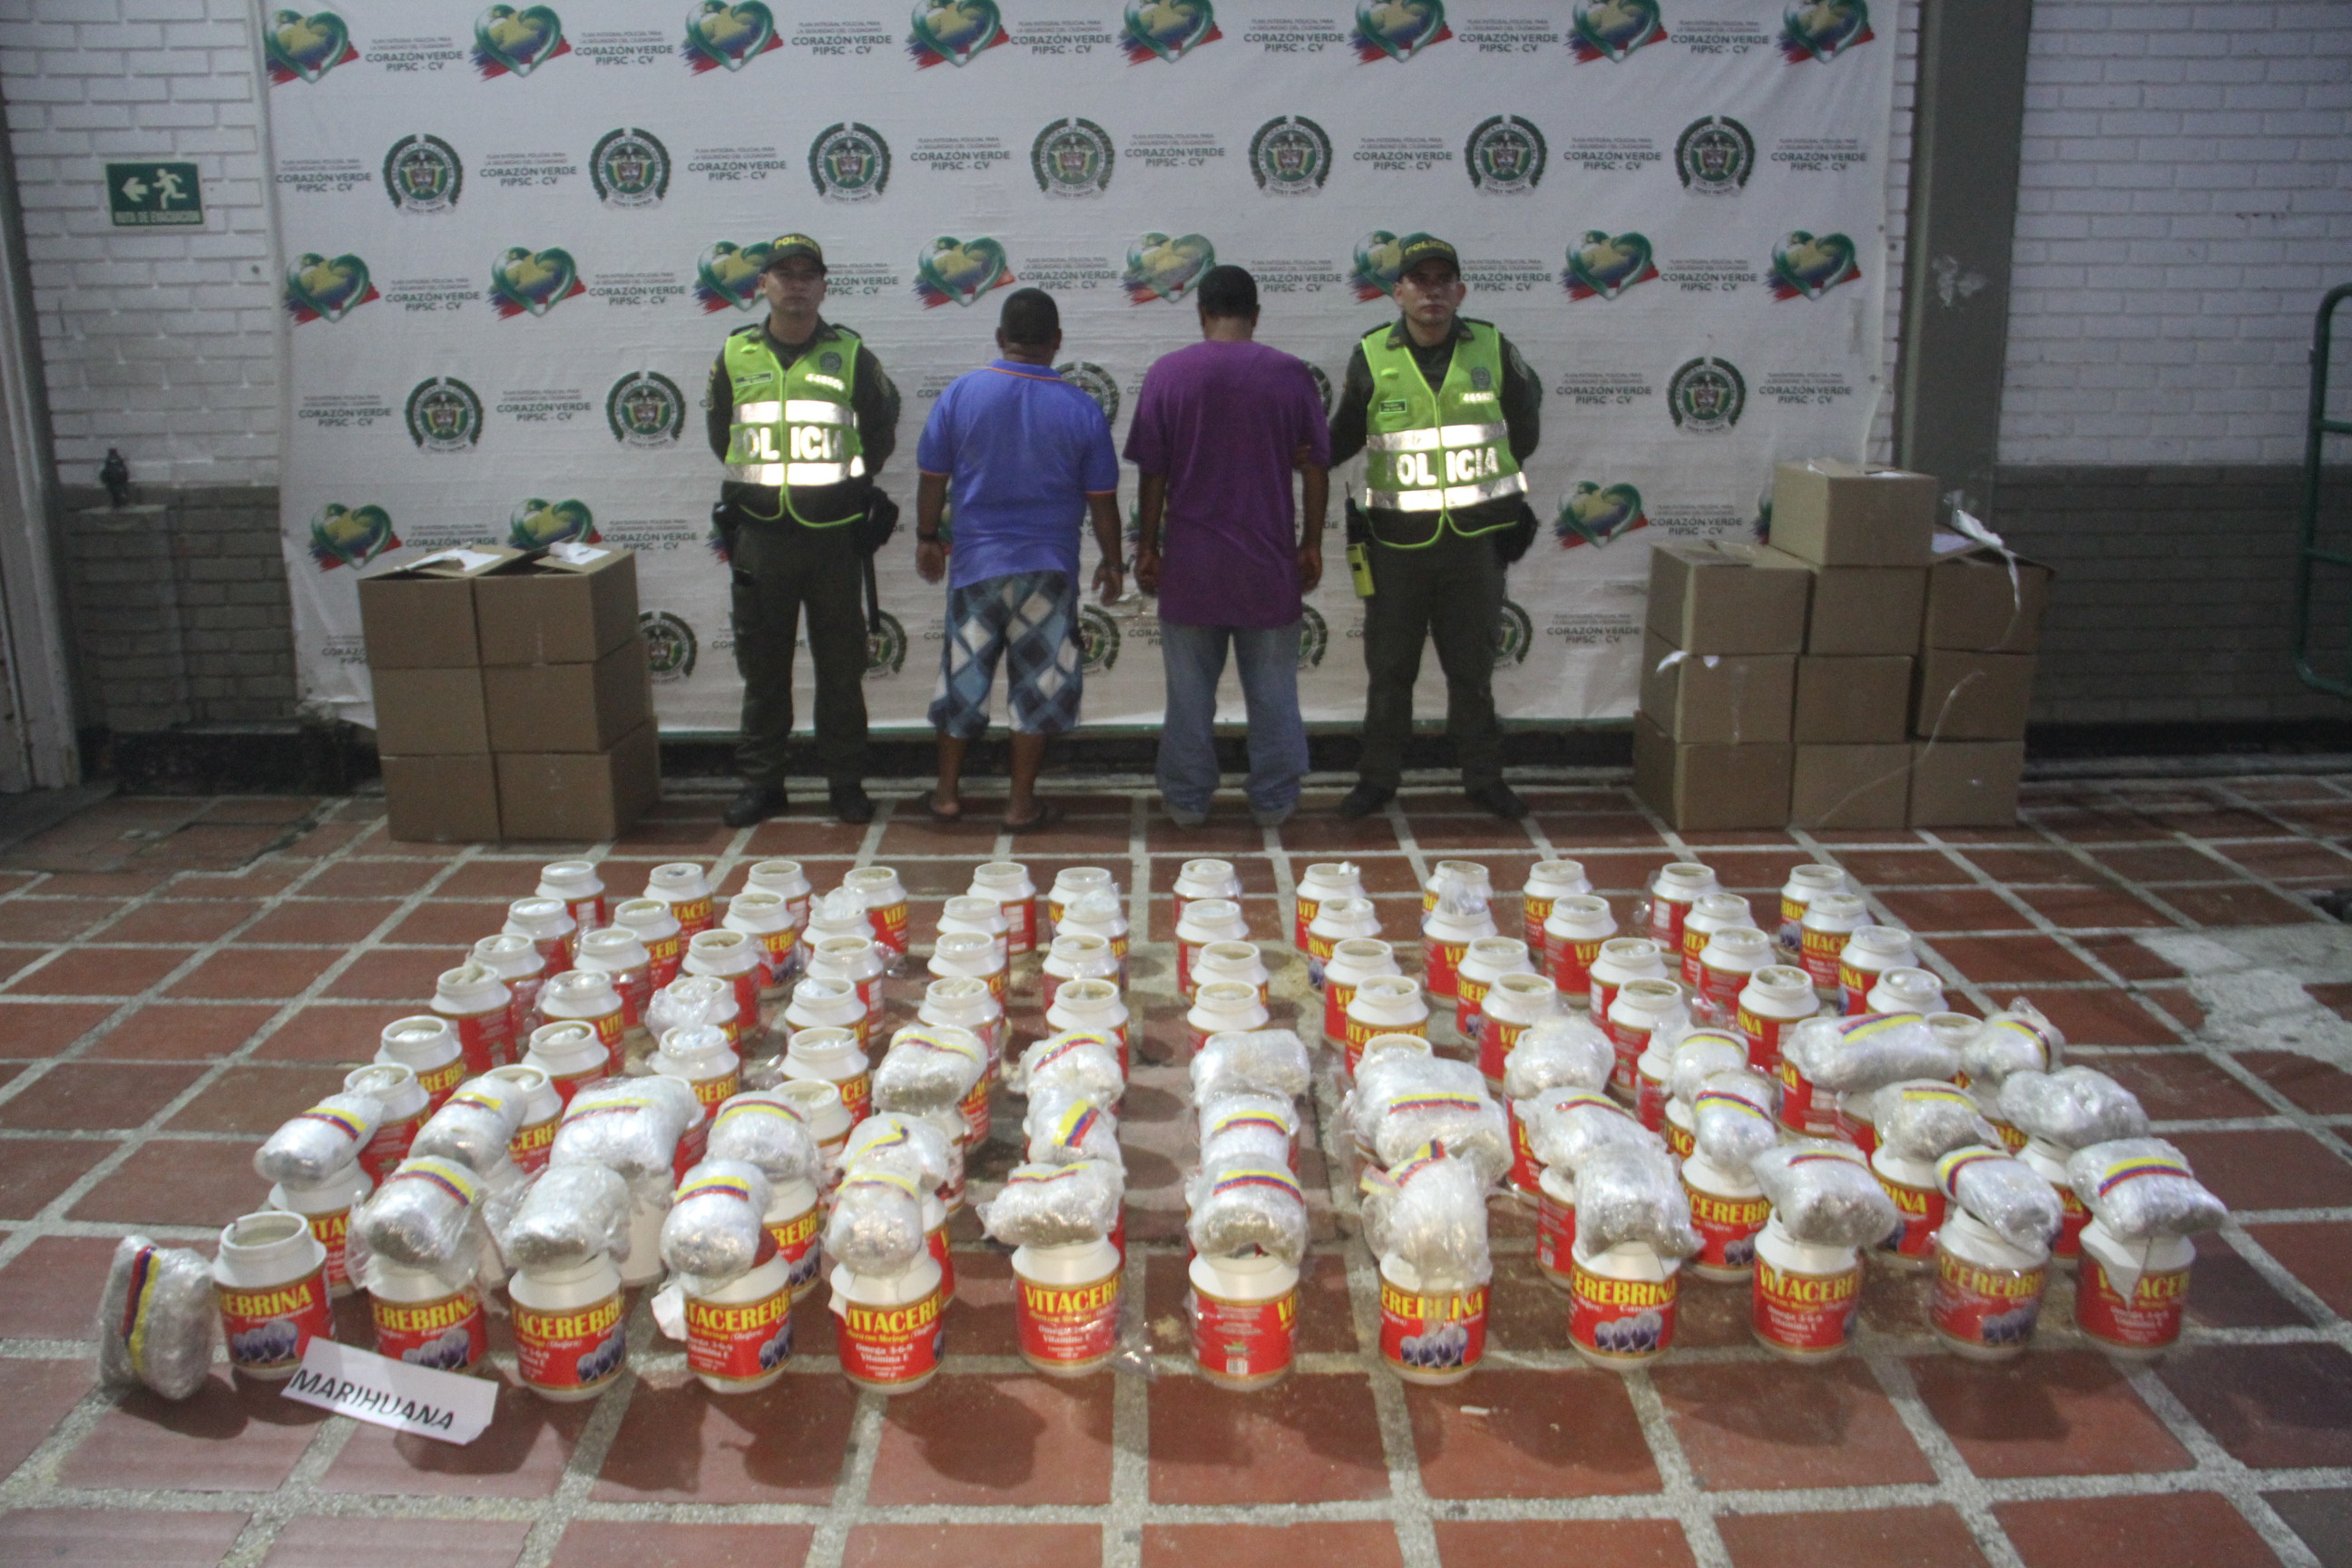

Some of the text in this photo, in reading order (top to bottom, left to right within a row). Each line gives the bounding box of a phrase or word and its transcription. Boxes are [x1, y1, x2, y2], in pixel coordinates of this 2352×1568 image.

[854, 34, 892, 44] VERDE
[1074, 34, 1111, 44] VERDE
[1307, 33, 1344, 42] VERDE
[1521, 34, 1558, 43] VERDE
[1732, 35, 1769, 44] VERDE
[636, 44, 673, 54] VERDE
[813, 45, 871, 55] PIPSC CV
[1033, 45, 1091, 54] PIPSC CV
[1265, 44, 1324, 52] PIPSC CV
[1480, 44, 1538, 53] PIPSC CV
[1691, 45, 1749, 54] PIPSC CV
[426, 51, 463, 60] VERDE
[596, 55, 653, 65] PIPSC CV
[387, 62, 444, 72] PIPSC CV
[973, 151, 1010, 160] VERDE
[1187, 148, 1225, 156] VERDE
[1416, 152, 1453, 160] VERDE
[1625, 152, 1661, 161] VERDE
[1831, 152, 1867, 162] VERDE
[750, 161, 787, 170] VERDE
[931, 162, 990, 171] PIPSC CV
[1145, 158, 1204, 167] PIPSC CV
[1374, 162, 1432, 170] PIPSC CV
[1583, 162, 1615, 170] PIPSC
[1791, 162, 1822, 171] PIPSC
[540, 166, 577, 175] VERDE
[336, 172, 371, 181] VERDE
[709, 172, 767, 181] PIPSC CV
[500, 177, 557, 186] PIPSC CV
[297, 183, 352, 192] PIPSC CV
[1079, 270, 1117, 279] VERDE
[1721, 273, 1757, 281] VERDE
[649, 286, 685, 295] VERDE
[444, 291, 480, 300] VERDE
[1616, 387, 1651, 395] VERDE
[1818, 387, 1852, 395] VERDE
[555, 402, 592, 411] VERDE
[356, 407, 391, 416] VERDE
[1708, 517, 1742, 525] VERDE
[662, 533, 697, 541] VERDE
[1604, 627, 1639, 635] VERDE
[856, 1343, 886, 1355] Omega
[861, 1352, 901, 1363] Vitamina
[289, 1368, 455, 1430] MARIHUANA
